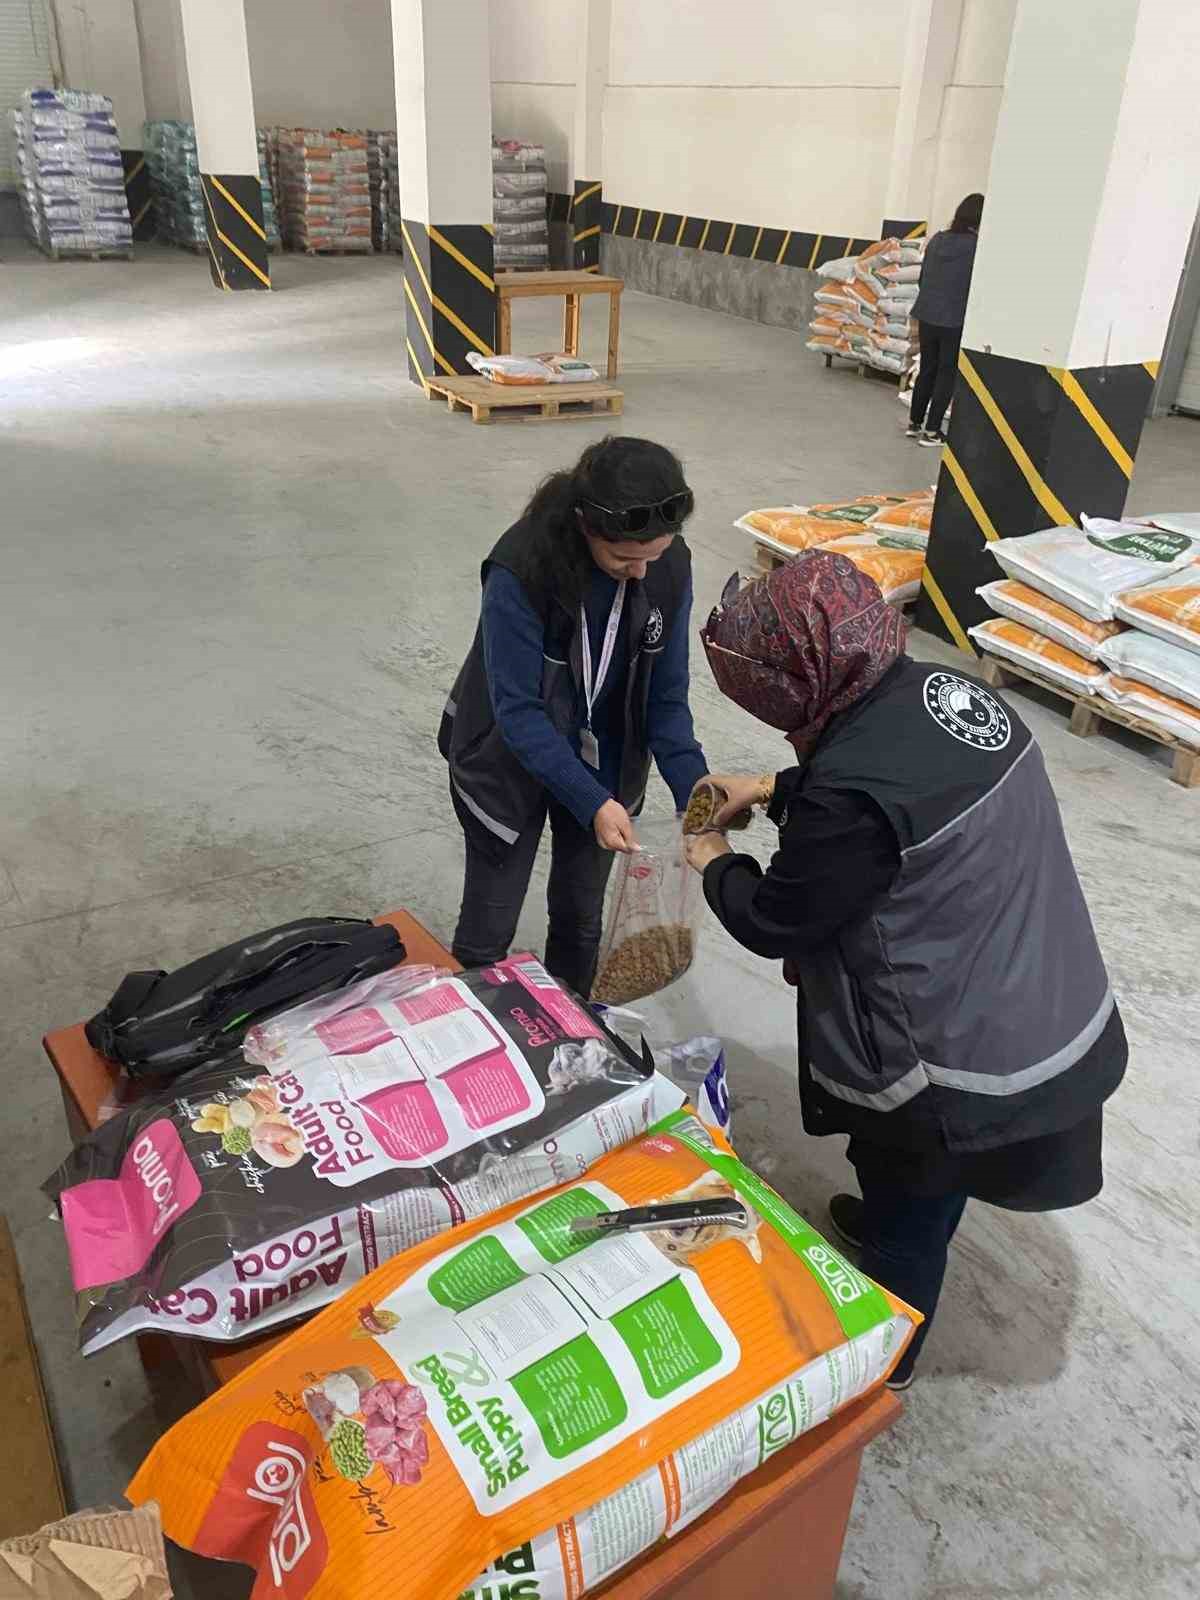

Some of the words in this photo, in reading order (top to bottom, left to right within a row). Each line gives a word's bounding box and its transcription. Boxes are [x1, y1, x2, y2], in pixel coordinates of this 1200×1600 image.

[272, 1070, 304, 1104] Cat
[292, 1102, 346, 1177] Adult
[320, 1100, 374, 1166] Food
[233, 1216, 343, 1282] Food
[230, 1252, 348, 1322] Adult
[416, 1354, 471, 1428] Breed
[457, 1422, 506, 1498] Small
[475, 1397, 529, 1482] Puppy
